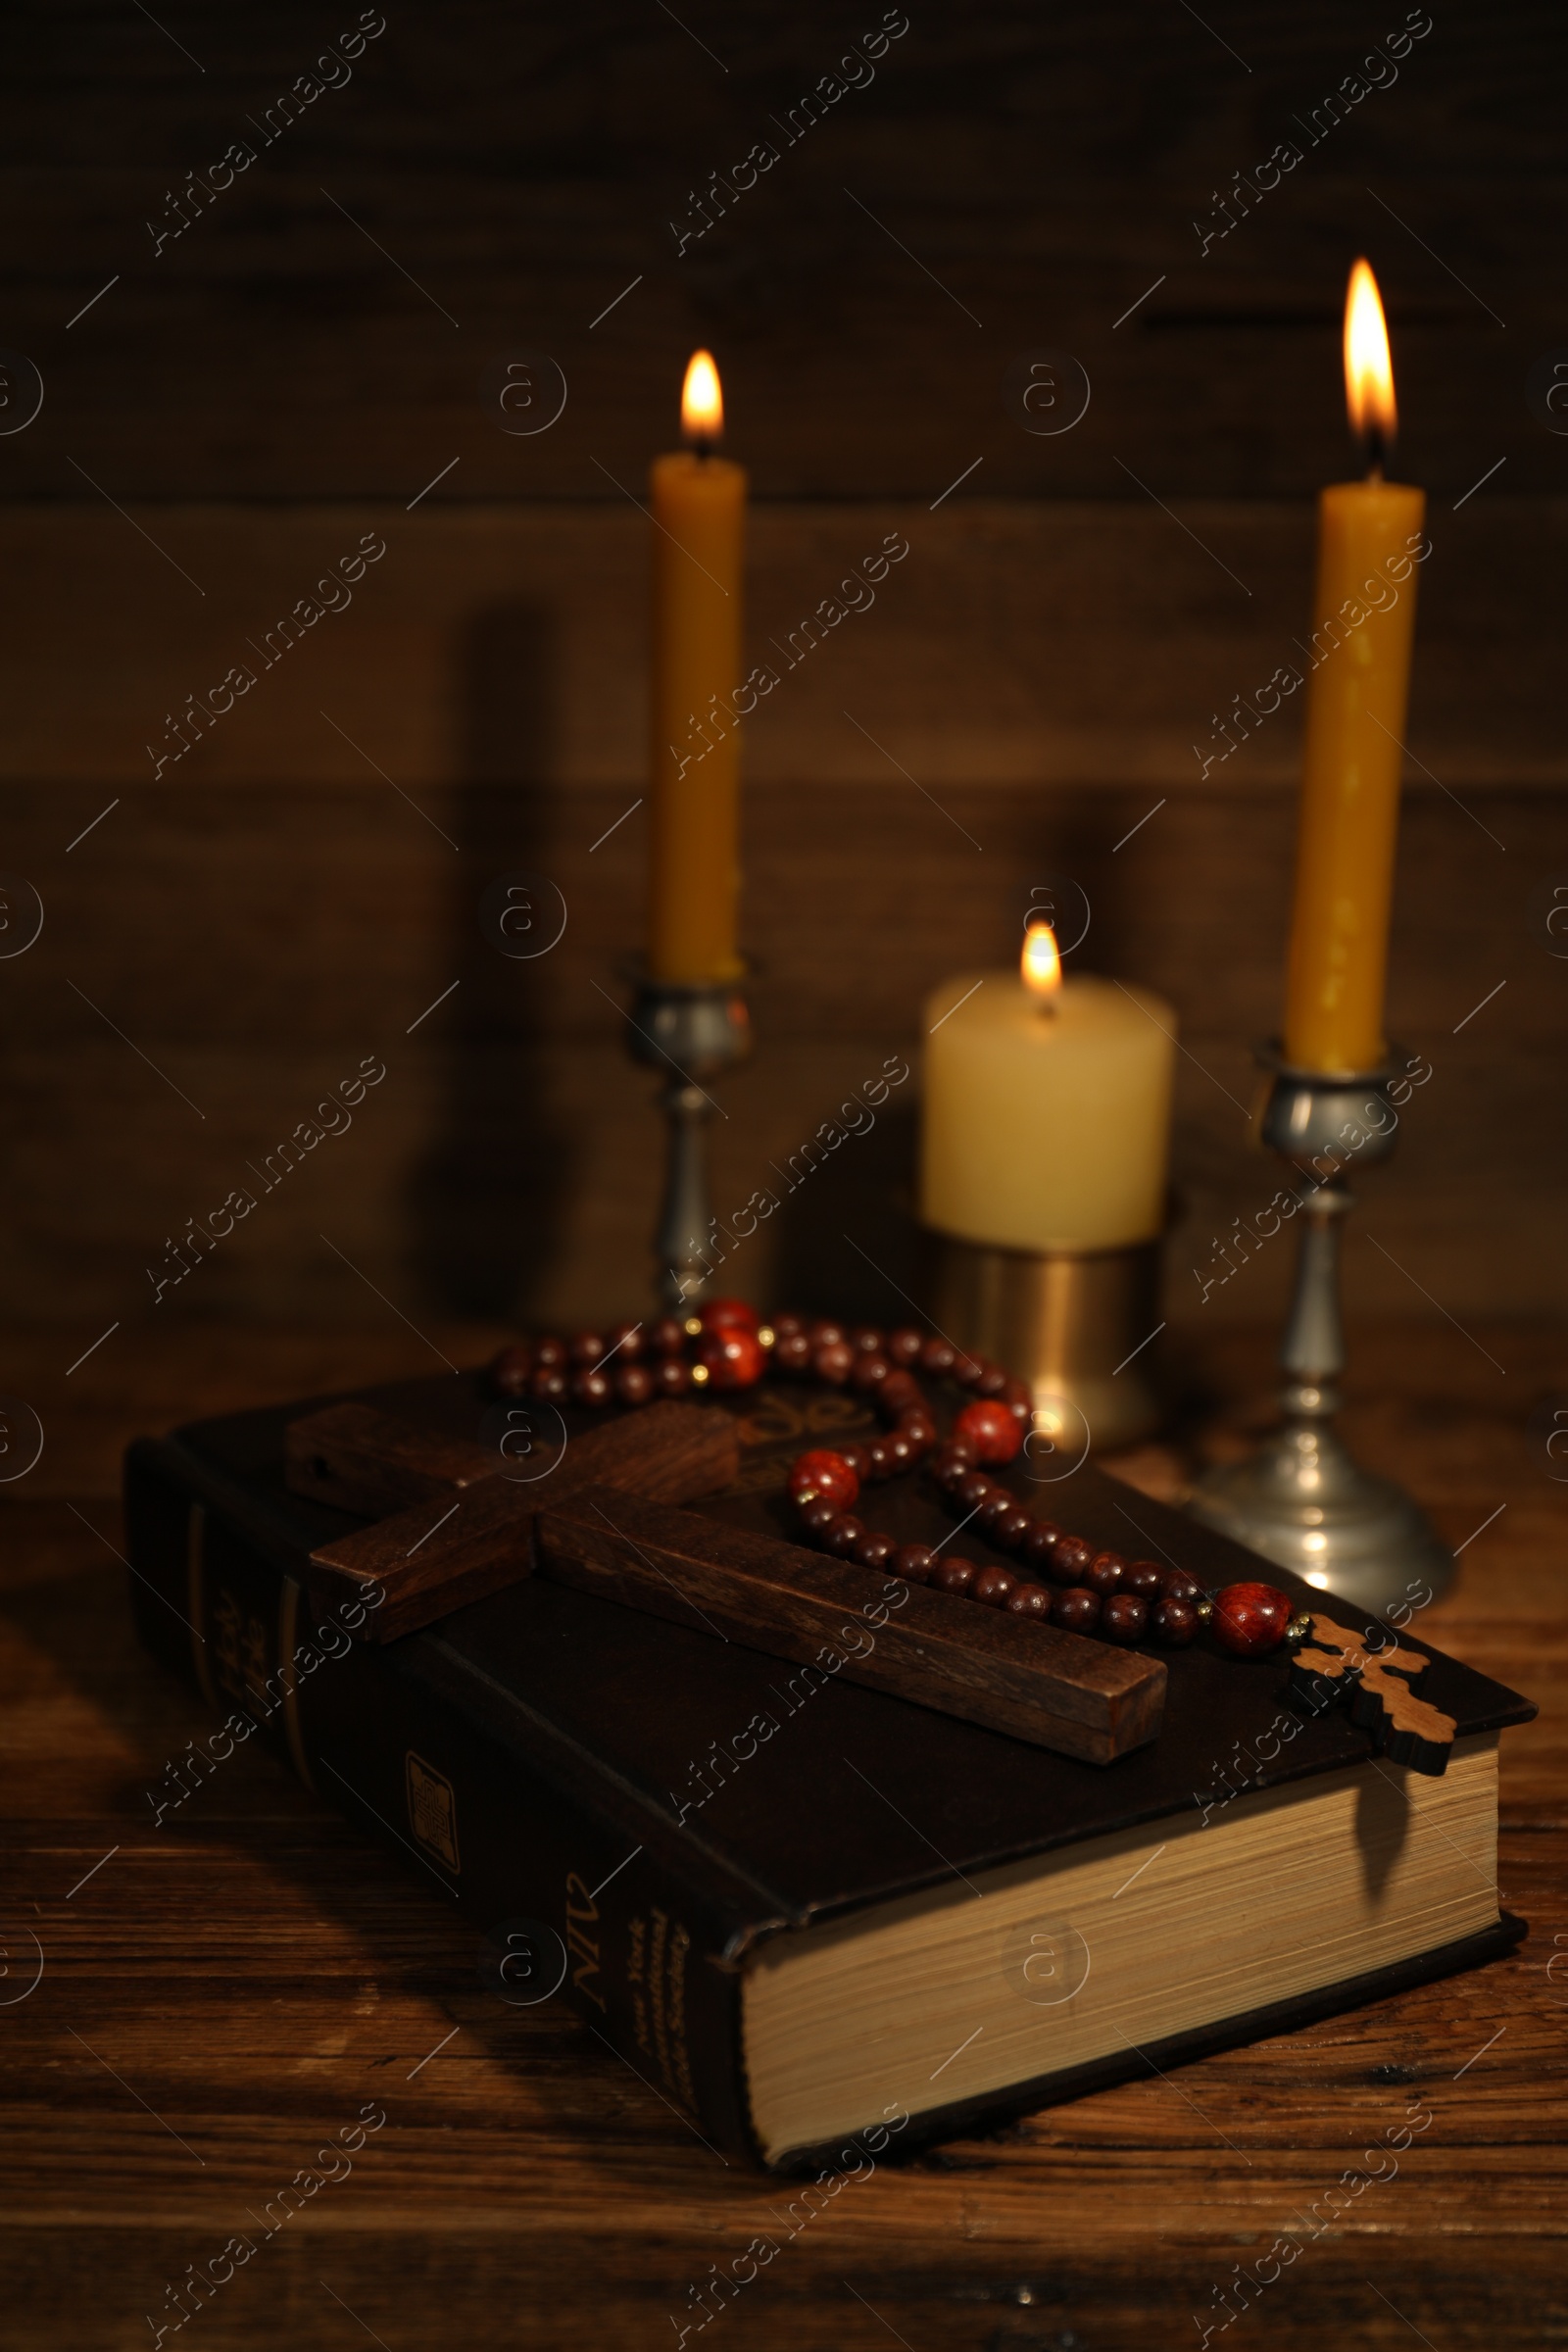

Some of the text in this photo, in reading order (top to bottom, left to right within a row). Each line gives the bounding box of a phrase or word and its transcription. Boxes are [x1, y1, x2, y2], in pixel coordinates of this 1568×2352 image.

[565, 1870, 607, 2014] NIV
[626, 1916, 653, 2057] New York
[666, 1921, 691, 2038] Society
